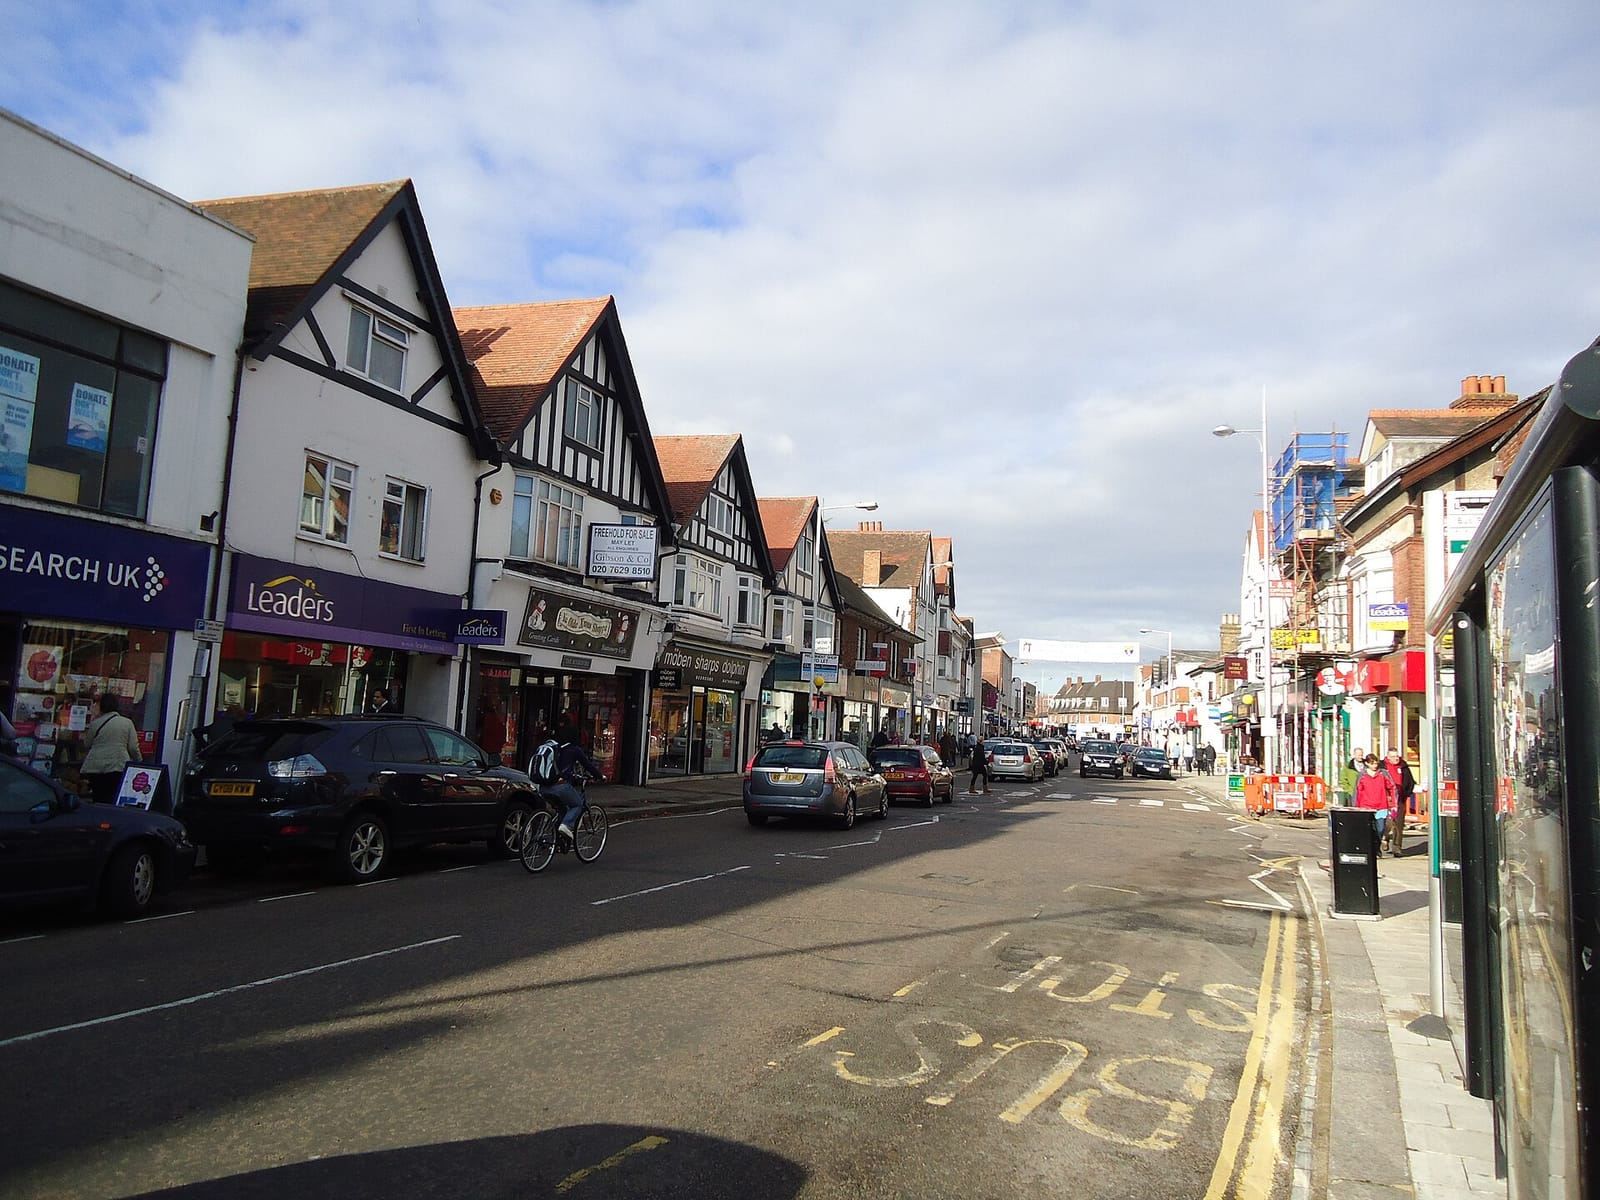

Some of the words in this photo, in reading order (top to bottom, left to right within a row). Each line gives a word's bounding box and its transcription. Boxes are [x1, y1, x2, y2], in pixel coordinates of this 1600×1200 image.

[594, 527, 624, 538] FREEHOLD
[626, 529, 637, 539] FOR
[639, 530, 654, 540] SALE
[595, 552, 624, 562] Gibson
[626, 555, 634, 563] &
[107, 562, 140, 589] UK
[592, 565, 607, 573] 020
[610, 566, 629, 574] 7629
[632, 567, 651, 575] 8510
[247, 582, 335, 623] Leaders
[1371, 606, 1406, 617] Leaders
[457, 624, 498, 637] Leaders
[663, 648, 692, 668] möben
[694, 655, 720, 675] sharps
[722, 660, 746, 678] dolphin
[833, 1019, 1213, 1151] BUS
